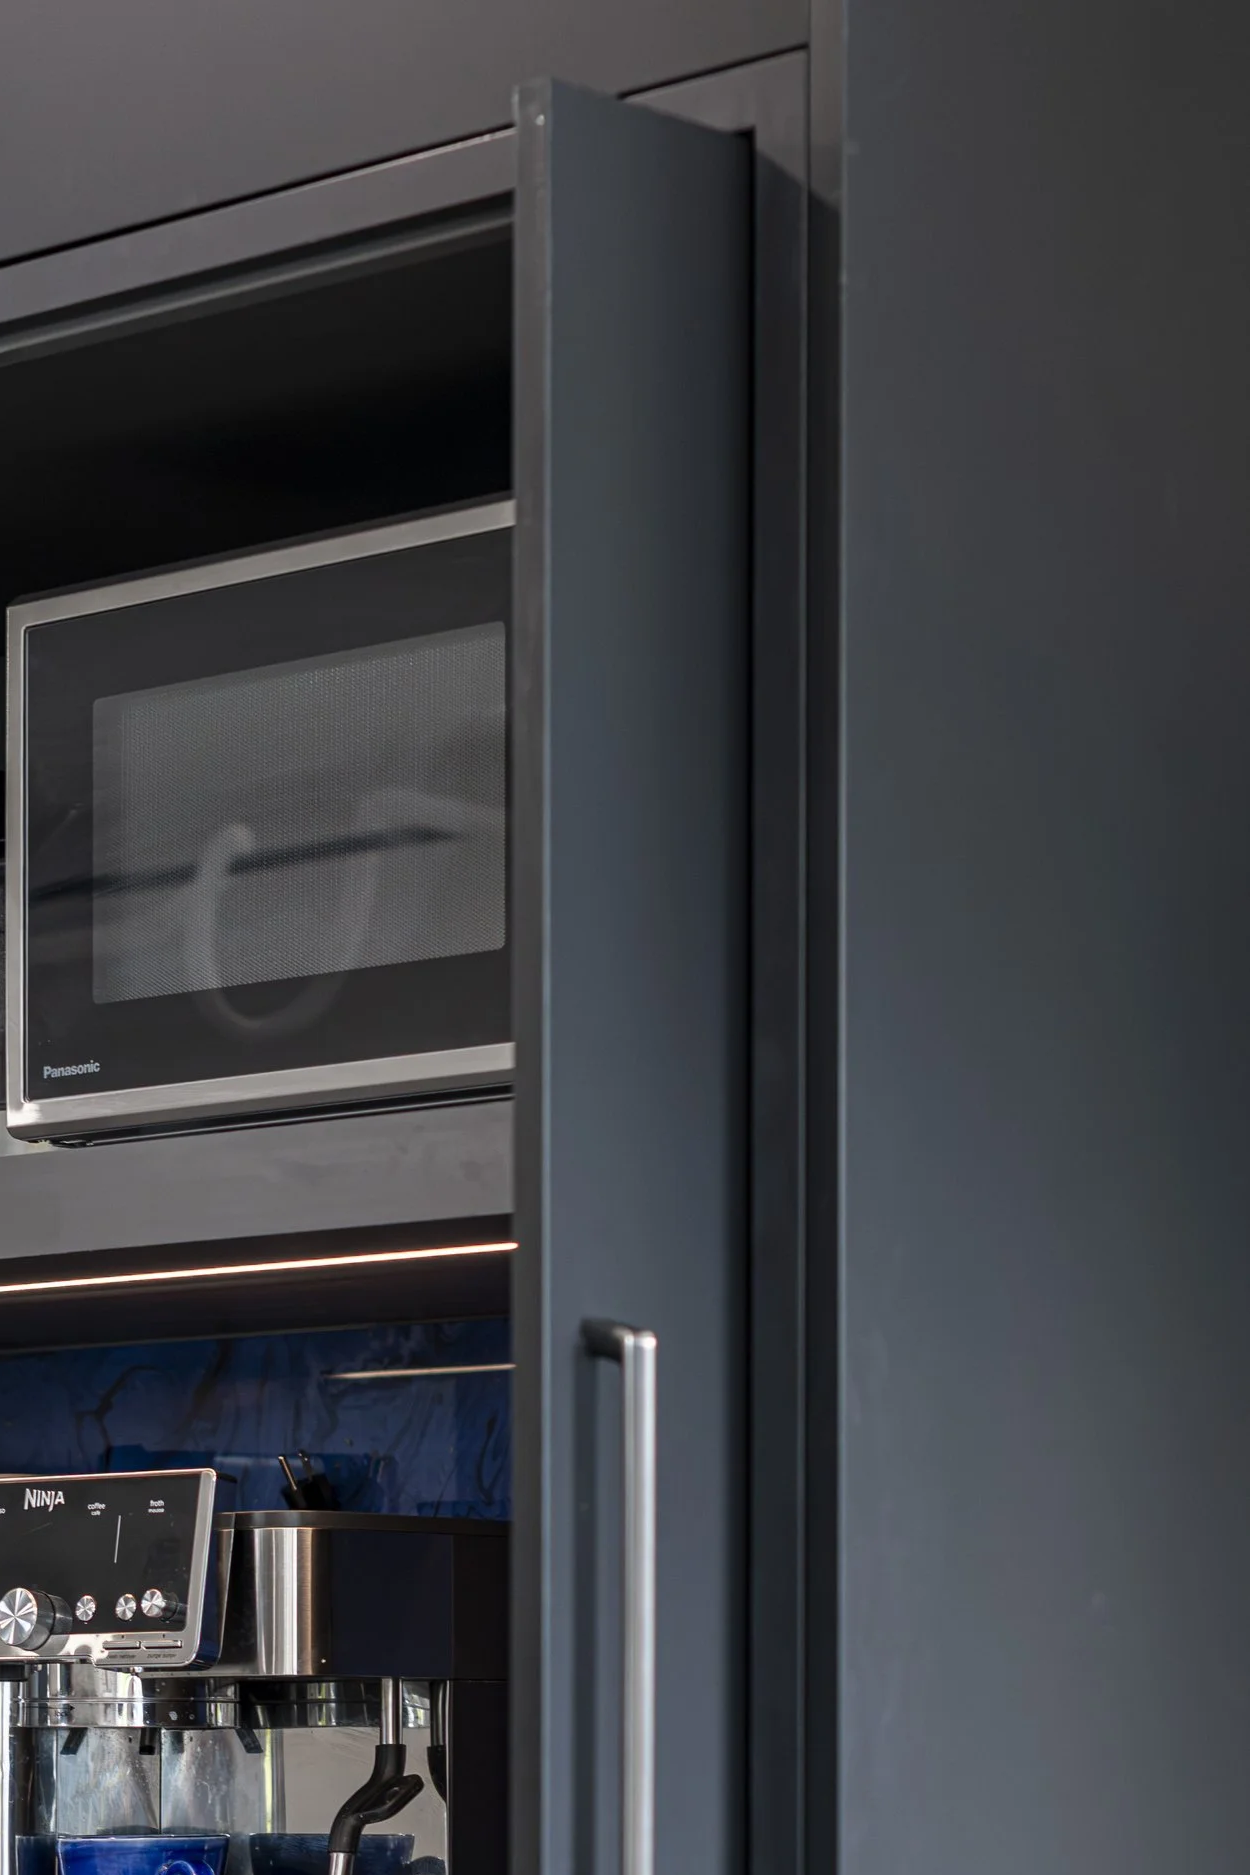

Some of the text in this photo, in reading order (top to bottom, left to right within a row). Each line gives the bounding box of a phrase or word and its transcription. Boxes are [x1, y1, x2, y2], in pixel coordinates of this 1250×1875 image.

[43, 1060, 101, 1079] Panasonic
[23, 1488, 65, 1512] NINJA
[87, 1502, 106, 1510] coffee
